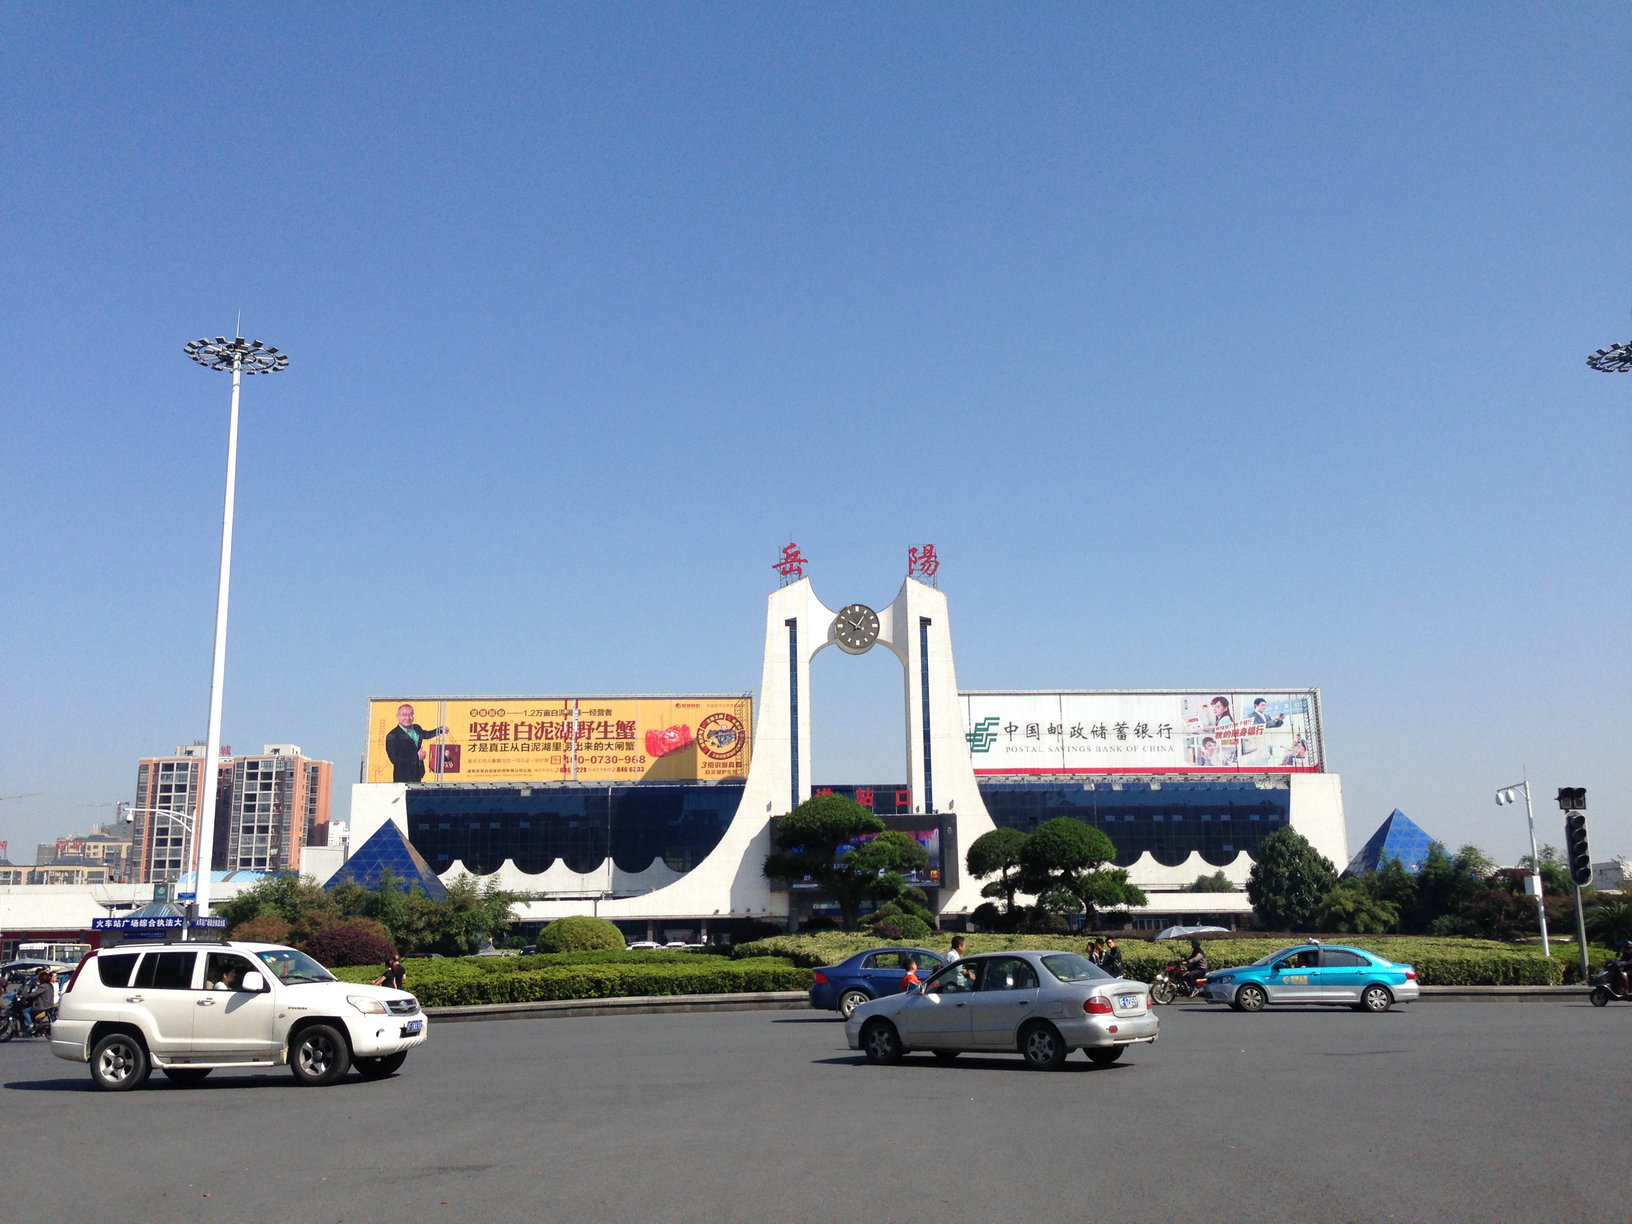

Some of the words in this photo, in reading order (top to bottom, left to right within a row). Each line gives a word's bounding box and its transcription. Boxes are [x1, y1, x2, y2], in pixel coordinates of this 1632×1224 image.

[772, 542, 808, 576] 岳
[908, 543, 940, 577] 陽
[1003, 721, 1173, 743] 中国邮政储蓄银行
[1005, 745, 1044, 753] POSTAL
[1048, 745, 1092, 753] SAVINGS
[1095, 745, 1123, 753] BANK
[1126, 745, 1139, 753] OF
[1142, 745, 1175, 753] CHINA
